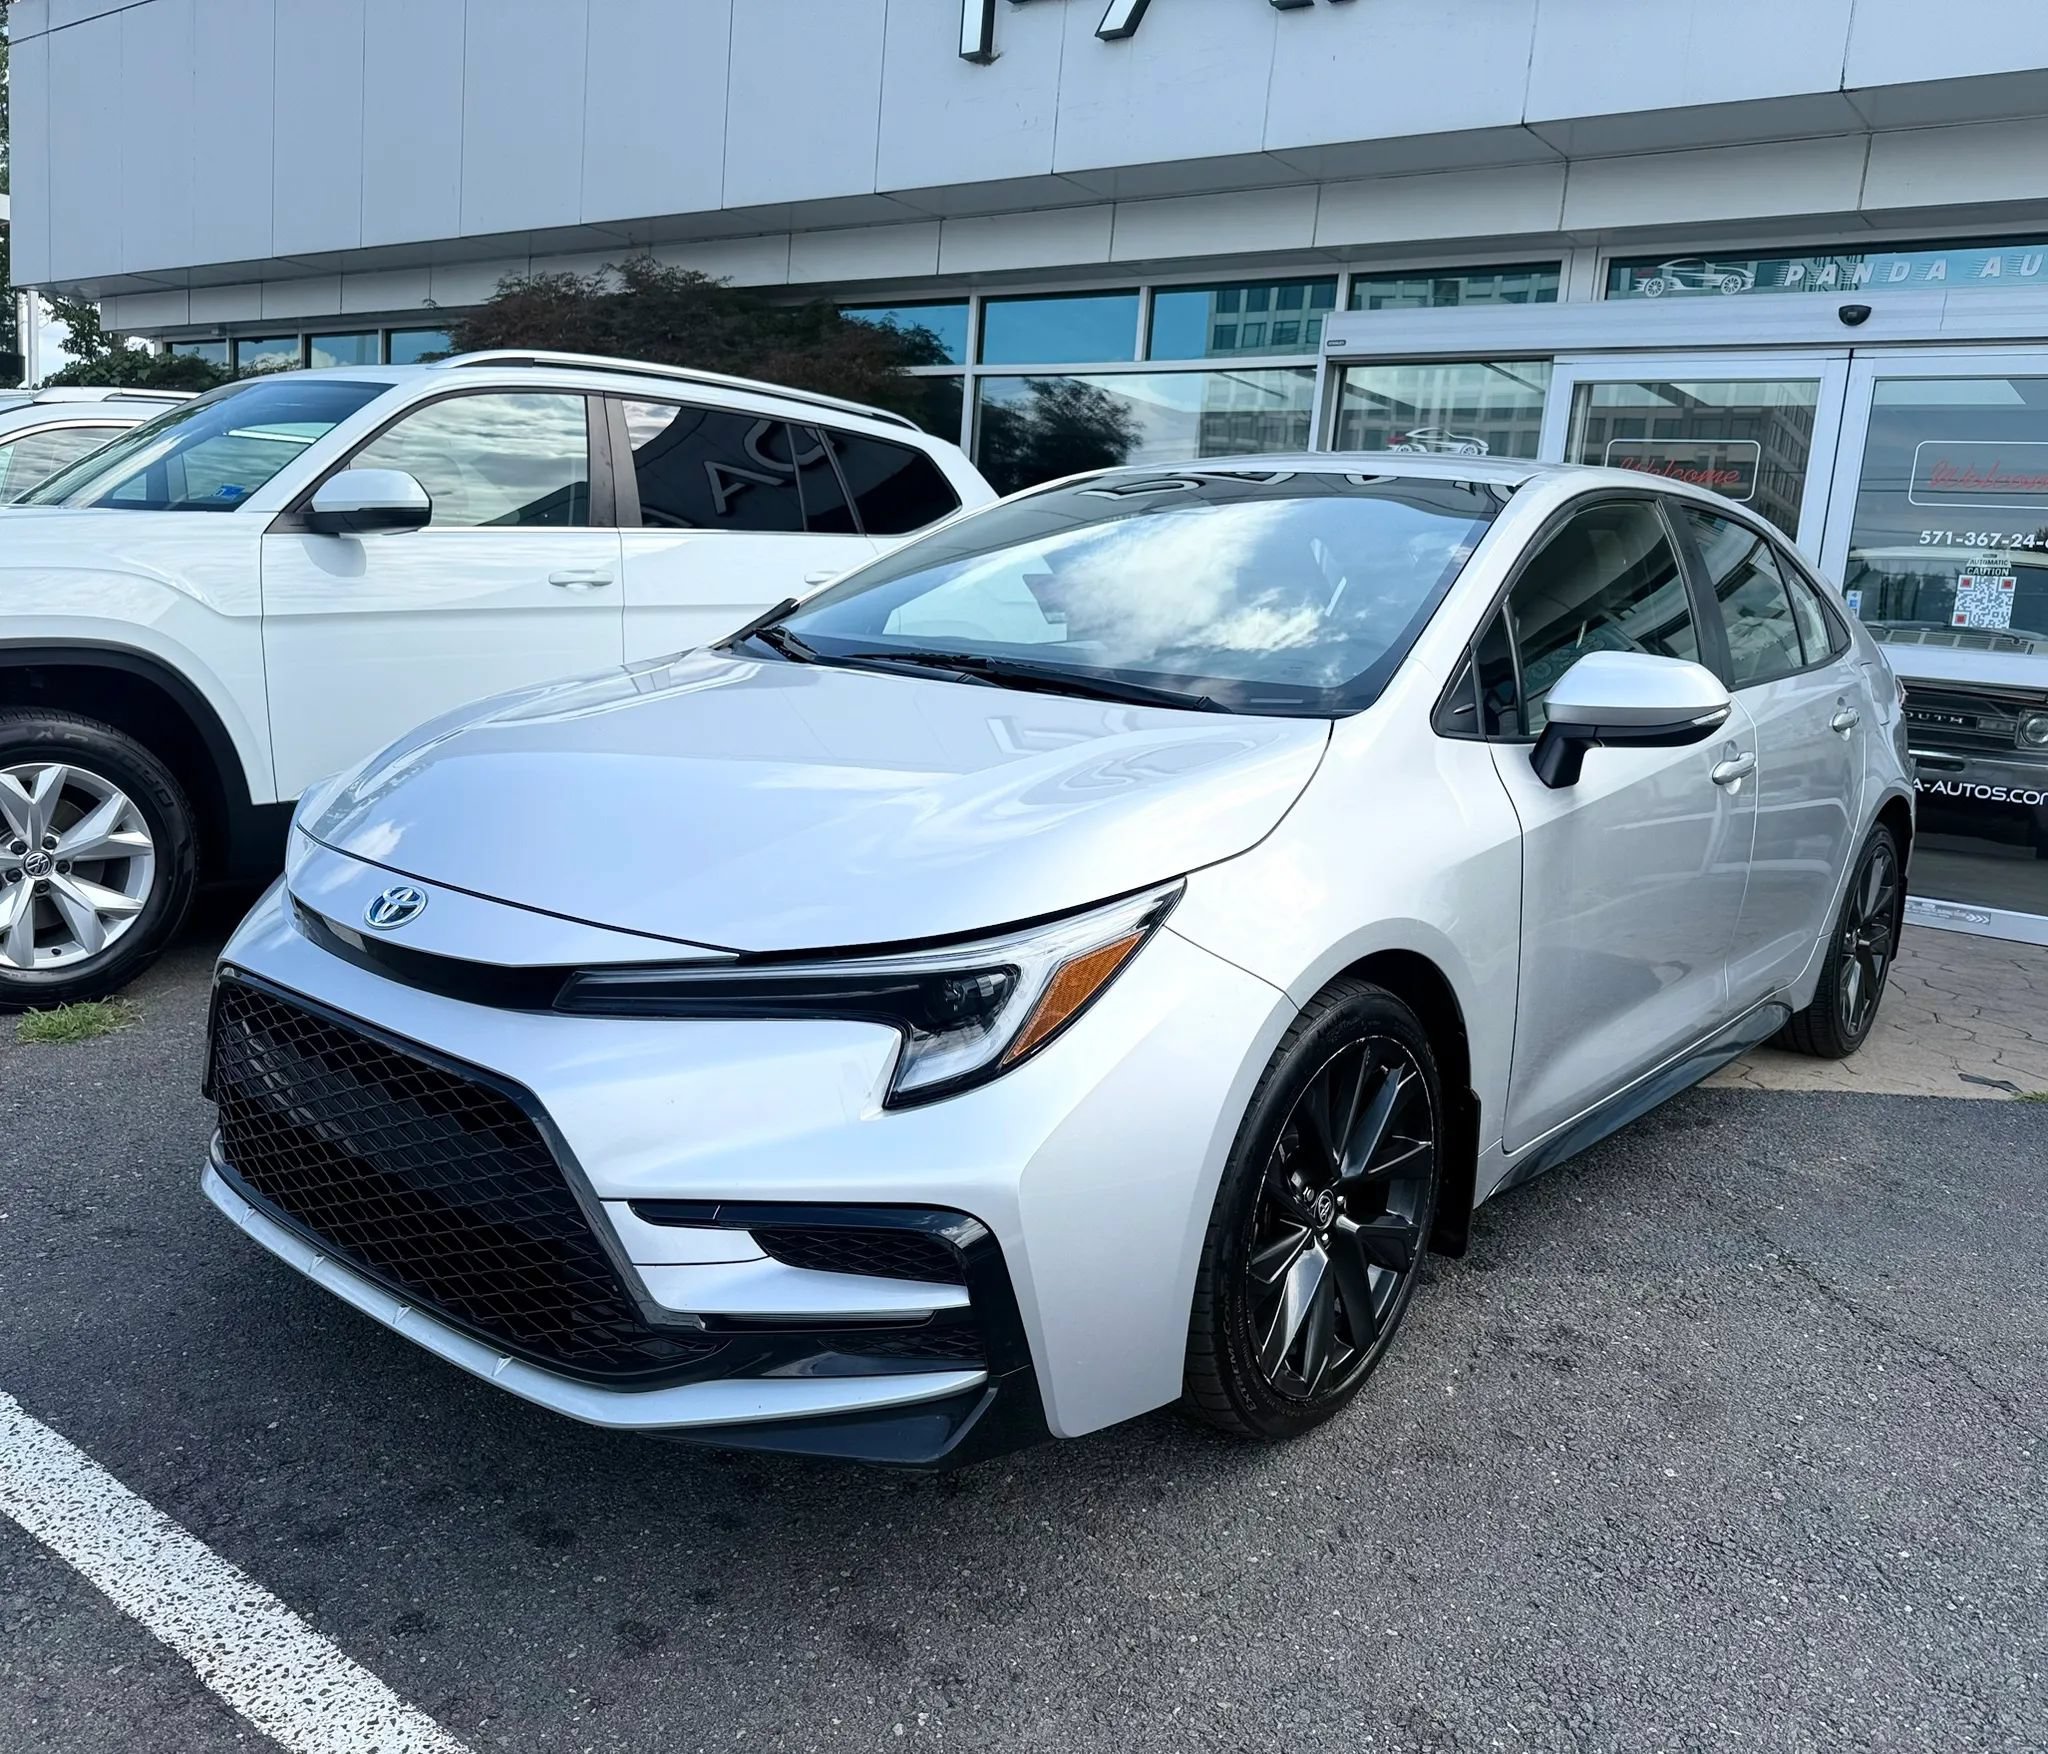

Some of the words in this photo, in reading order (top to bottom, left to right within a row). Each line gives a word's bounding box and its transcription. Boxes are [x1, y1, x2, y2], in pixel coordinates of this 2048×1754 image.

[1783, 259, 1947, 286] PANDA
[1919, 530, 2048, 549] 571-367-24-
[1966, 567, 2009, 577] CAUTION
